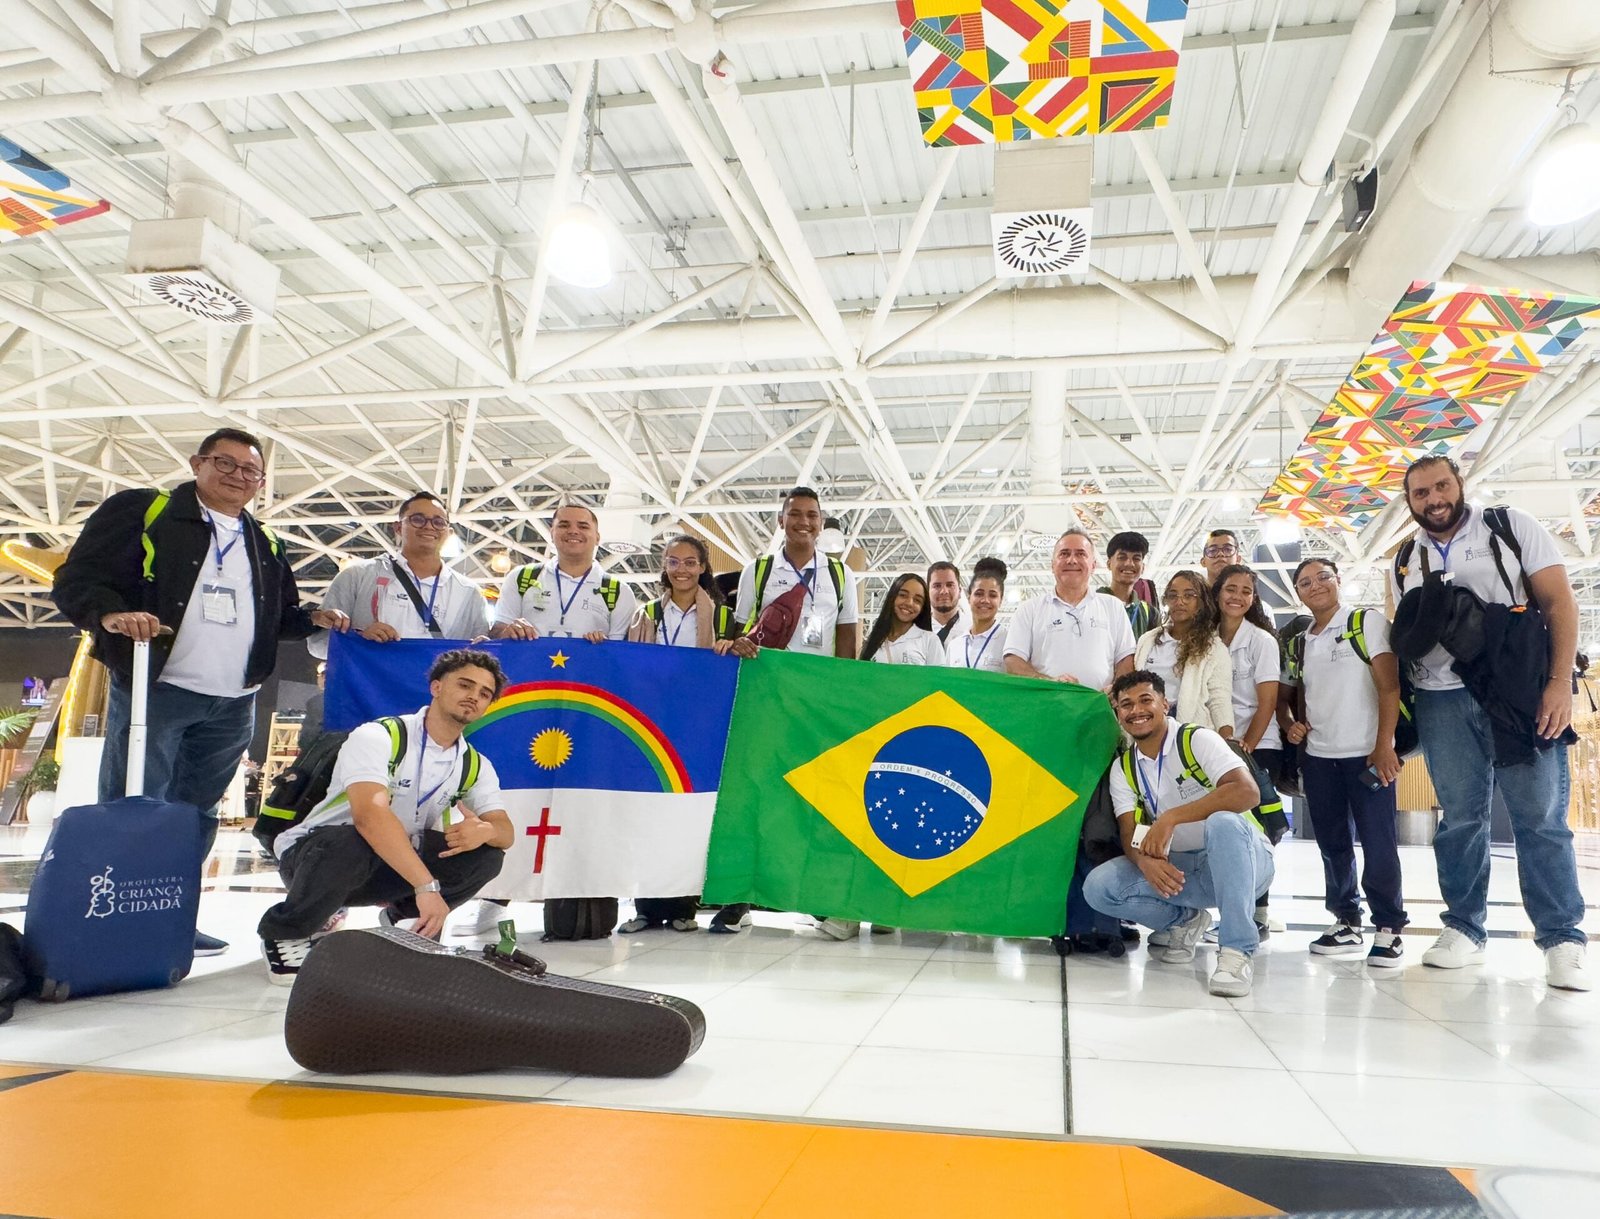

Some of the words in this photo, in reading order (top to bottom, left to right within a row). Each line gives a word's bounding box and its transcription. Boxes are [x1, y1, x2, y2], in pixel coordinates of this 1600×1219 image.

[880, 763, 913, 773] ORDEM
[924, 770, 977, 804] PROGRESSO
[119, 876, 183, 888] ORQUESTRA
[119, 885, 183, 899] CRIANÇA
[118, 895, 181, 913] CIDADÃ
